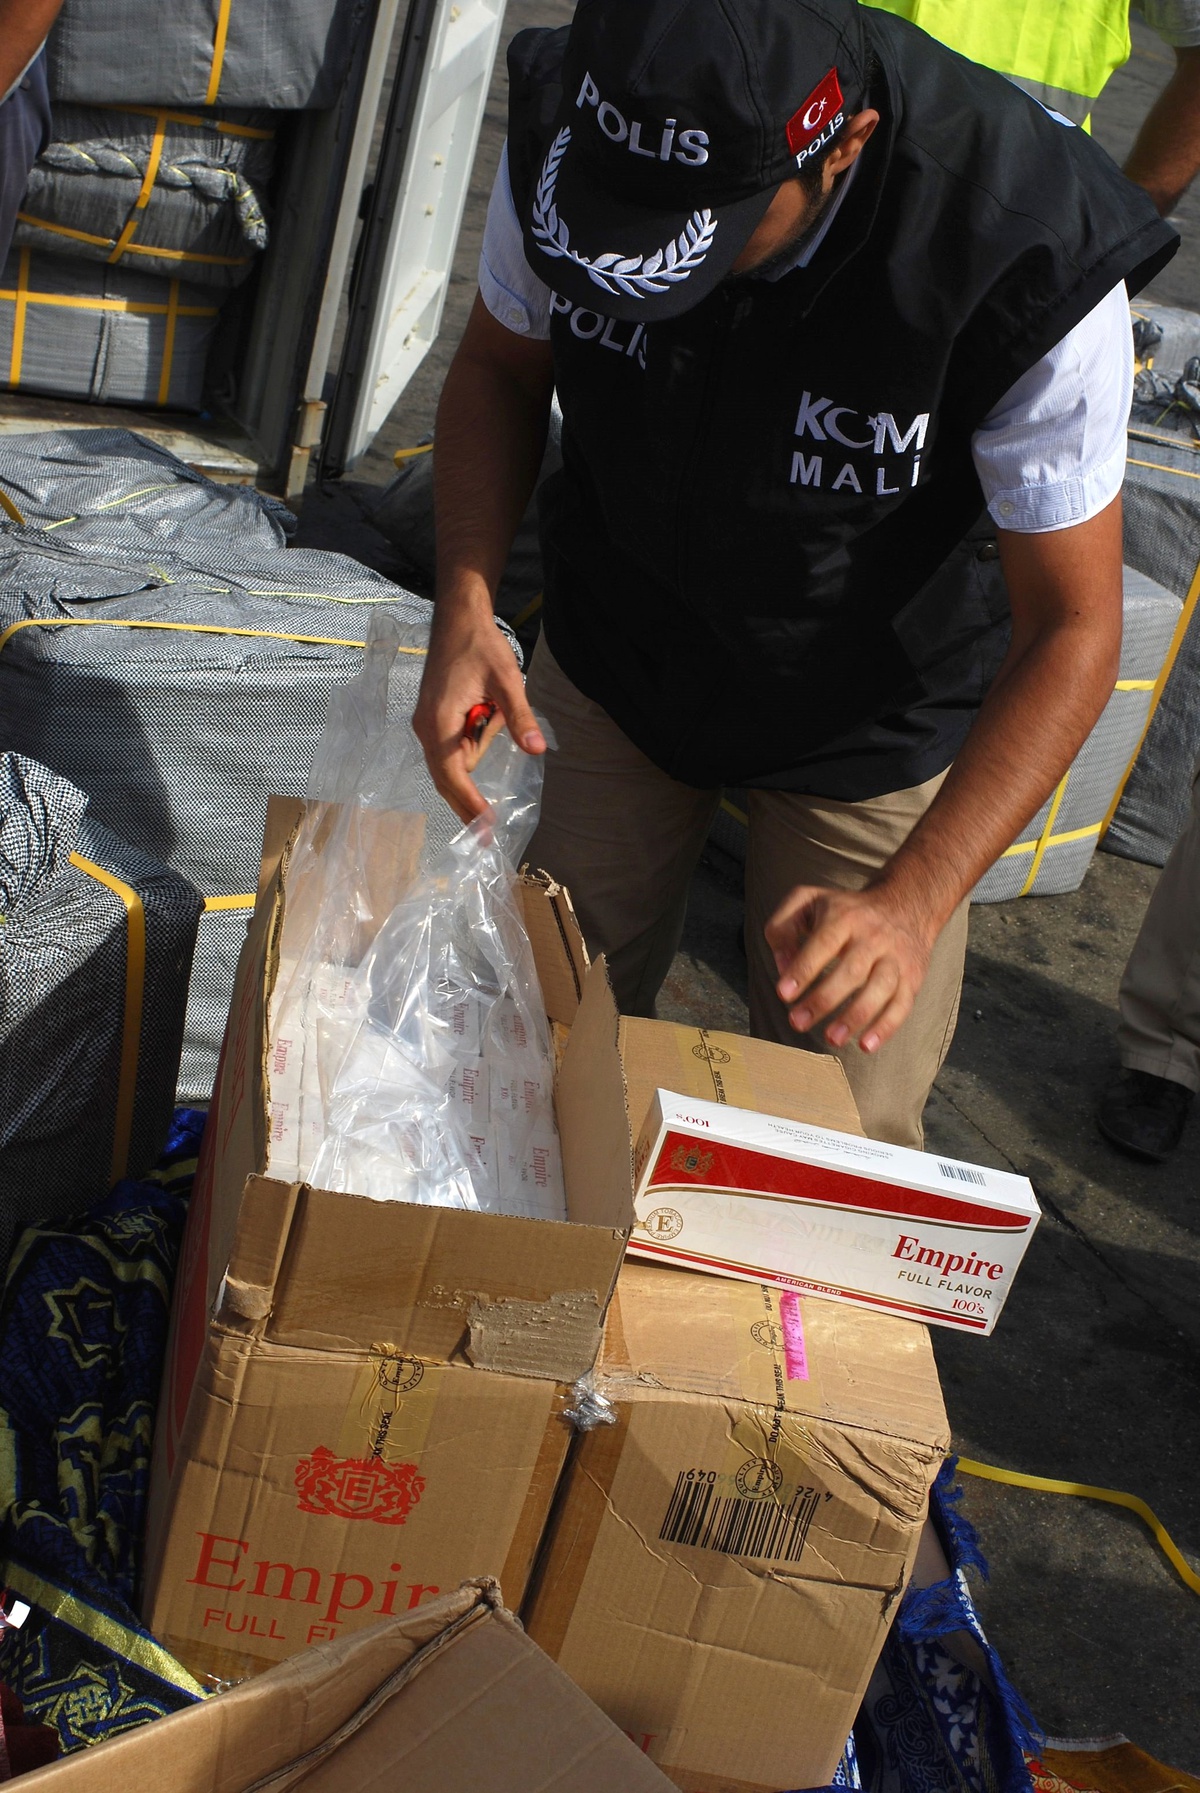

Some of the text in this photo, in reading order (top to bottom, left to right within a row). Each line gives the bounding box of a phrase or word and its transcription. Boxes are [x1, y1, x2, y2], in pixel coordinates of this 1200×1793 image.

[272, 1038, 294, 1075] Empire
[458, 1068, 480, 1105] Empire
[529, 1147, 552, 1188] Empire
[655, 1214, 674, 1232] E
[891, 1234, 1004, 1281] Empire
[775, 1276, 815, 1290] AMERICAN
[817, 1285, 842, 1297] BLEND
[898, 1270, 993, 1299] FULL FLAVOR
[951, 1298, 985, 1315] 100's
[768, 1431, 779, 1444] DO
[345, 1479, 370, 1503] E
[738, 1459, 757, 1494] QUALITY
[186, 1531, 441, 1625] Empir
[202, 1608, 287, 1641] FULL
